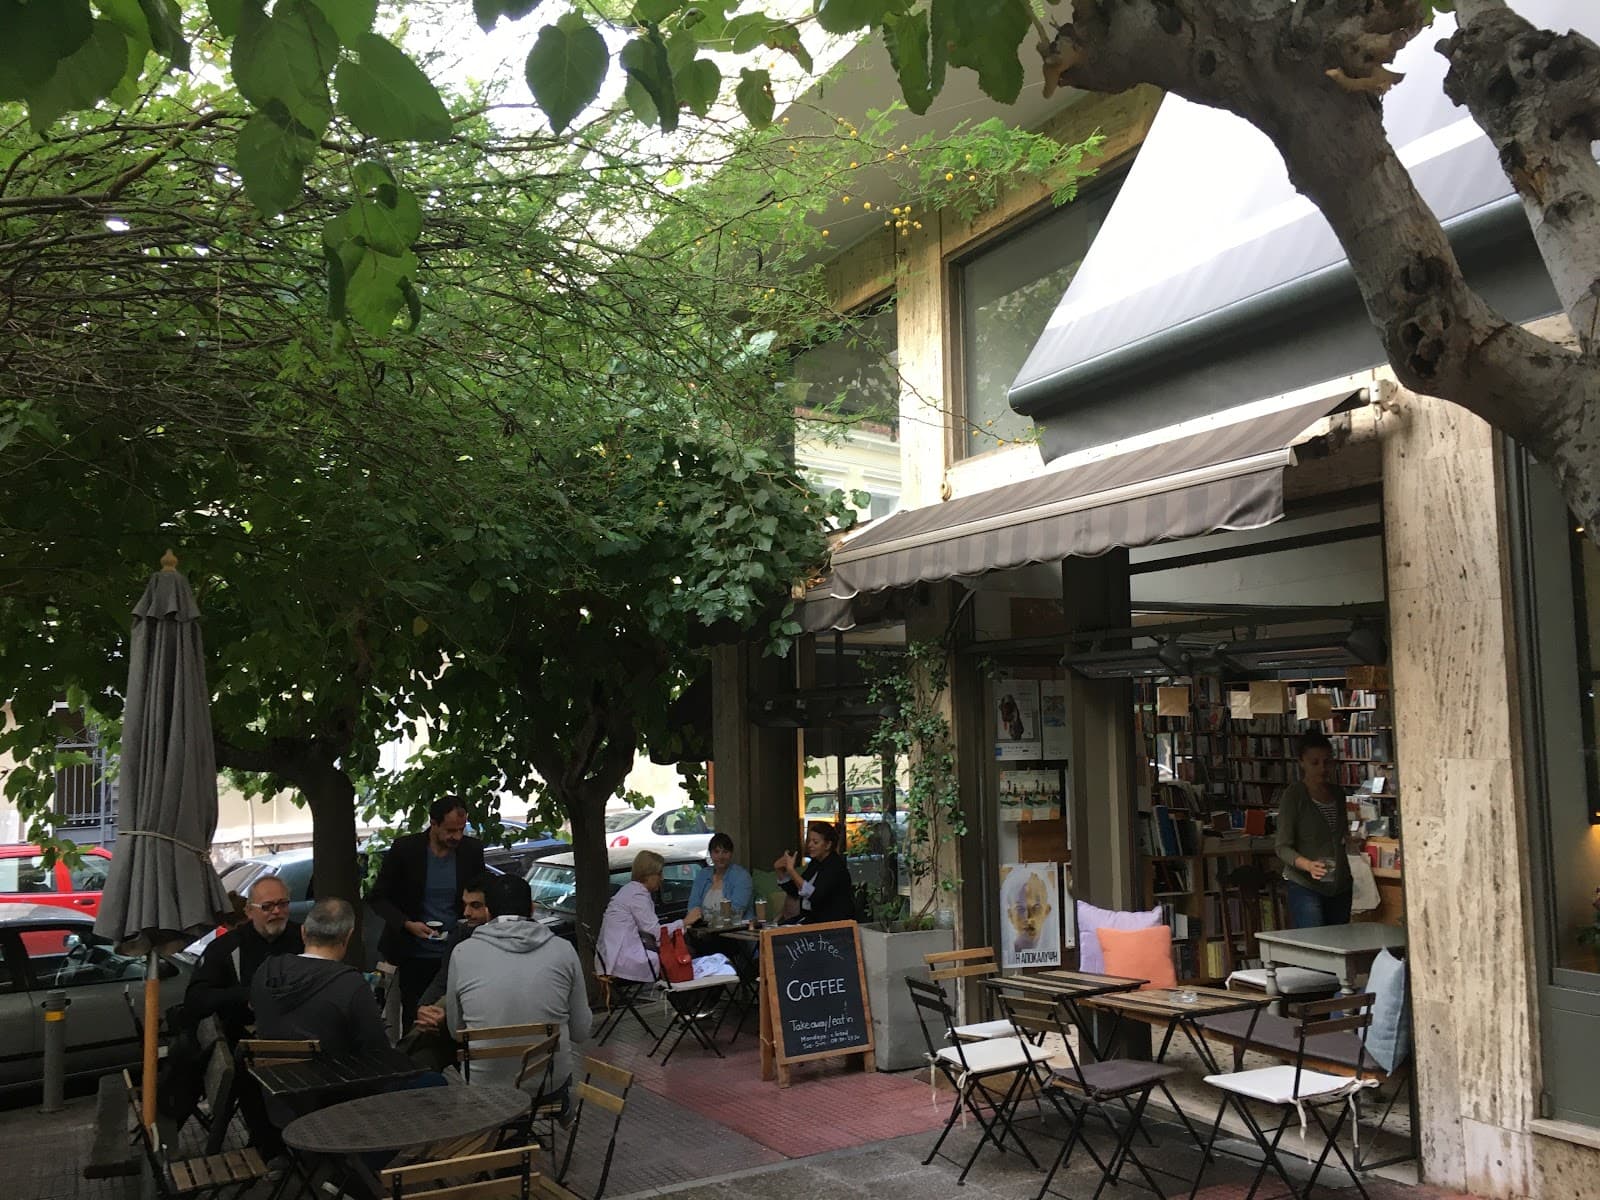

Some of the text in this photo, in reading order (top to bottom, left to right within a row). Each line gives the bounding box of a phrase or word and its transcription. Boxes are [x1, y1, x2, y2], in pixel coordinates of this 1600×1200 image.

[786, 934, 843, 960] little tree
[787, 978, 846, 1001] COFFEE
